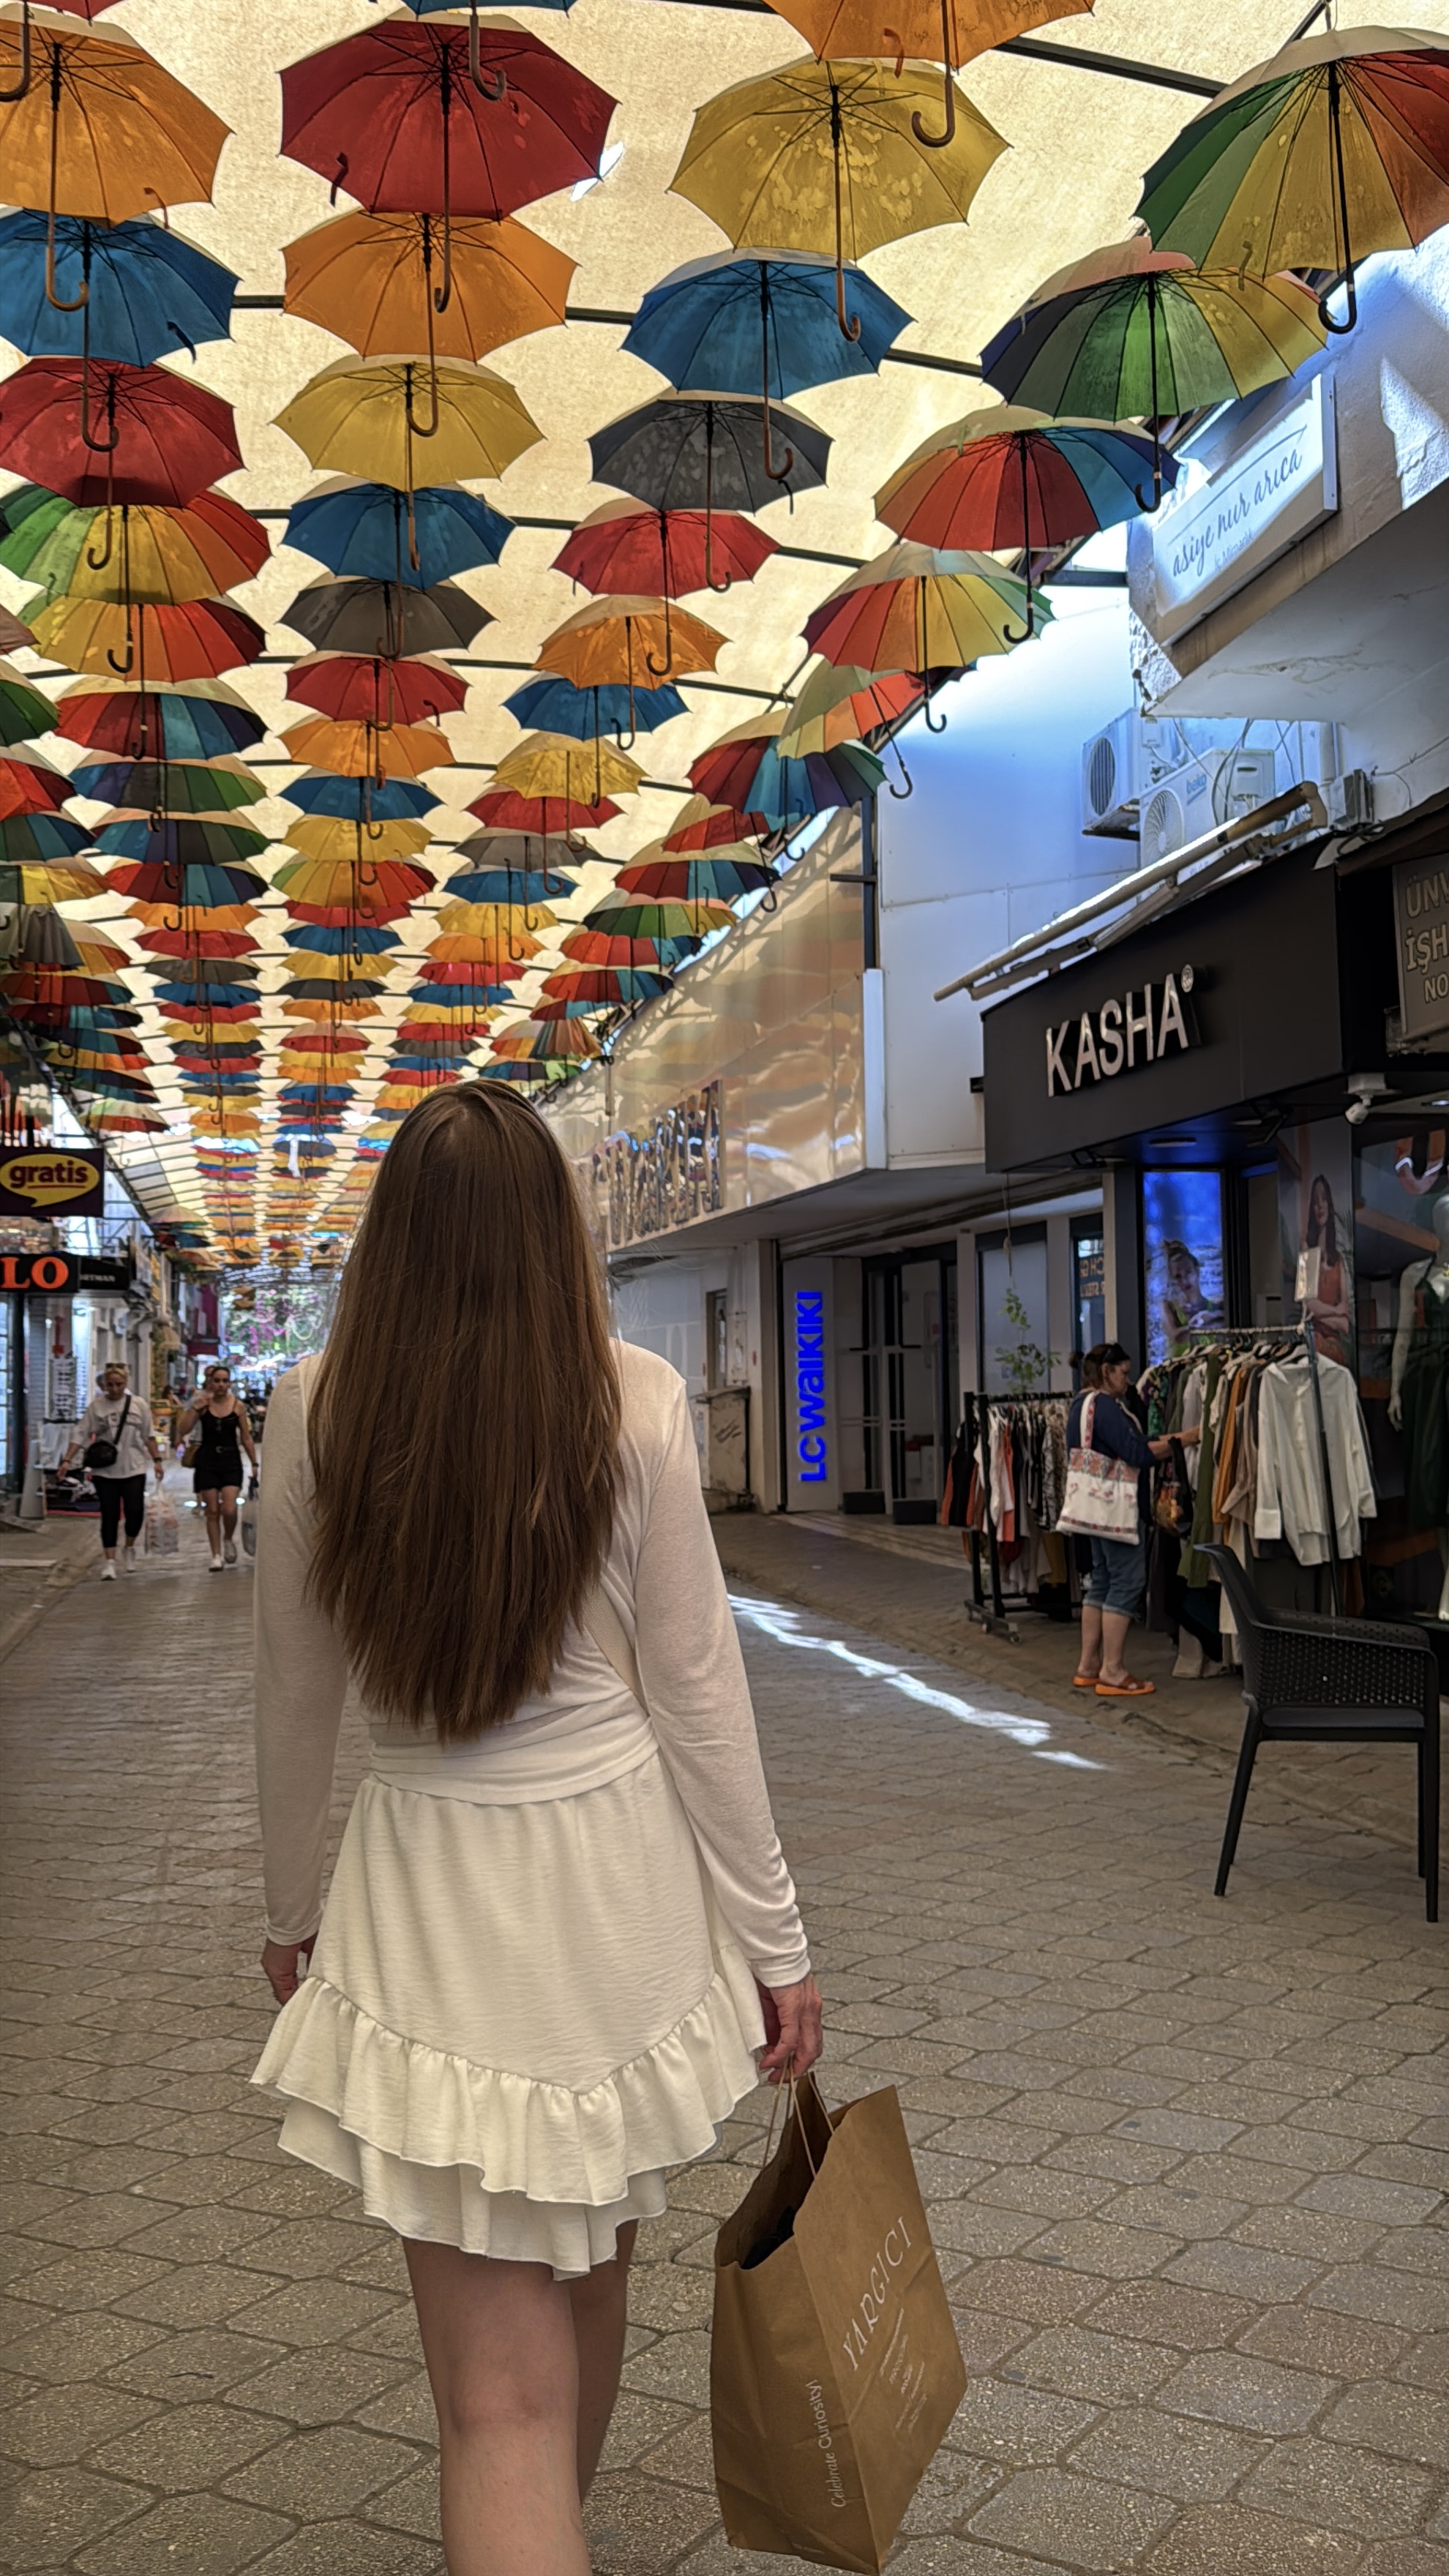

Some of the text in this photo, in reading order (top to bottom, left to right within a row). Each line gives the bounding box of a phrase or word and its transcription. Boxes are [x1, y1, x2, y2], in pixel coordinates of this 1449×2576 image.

[1173, 526, 1215, 577] asiye
[1218, 493, 1251, 539] nur
[1407, 923, 1448, 974] İŞH
[10, 1160, 88, 1188] gratis
[0, 1256, 69, 1289] LO
[798, 1436, 827, 1481] LC
[842, 2217, 912, 2372] YARGICI
[831, 2452, 846, 2509] Celebrate
